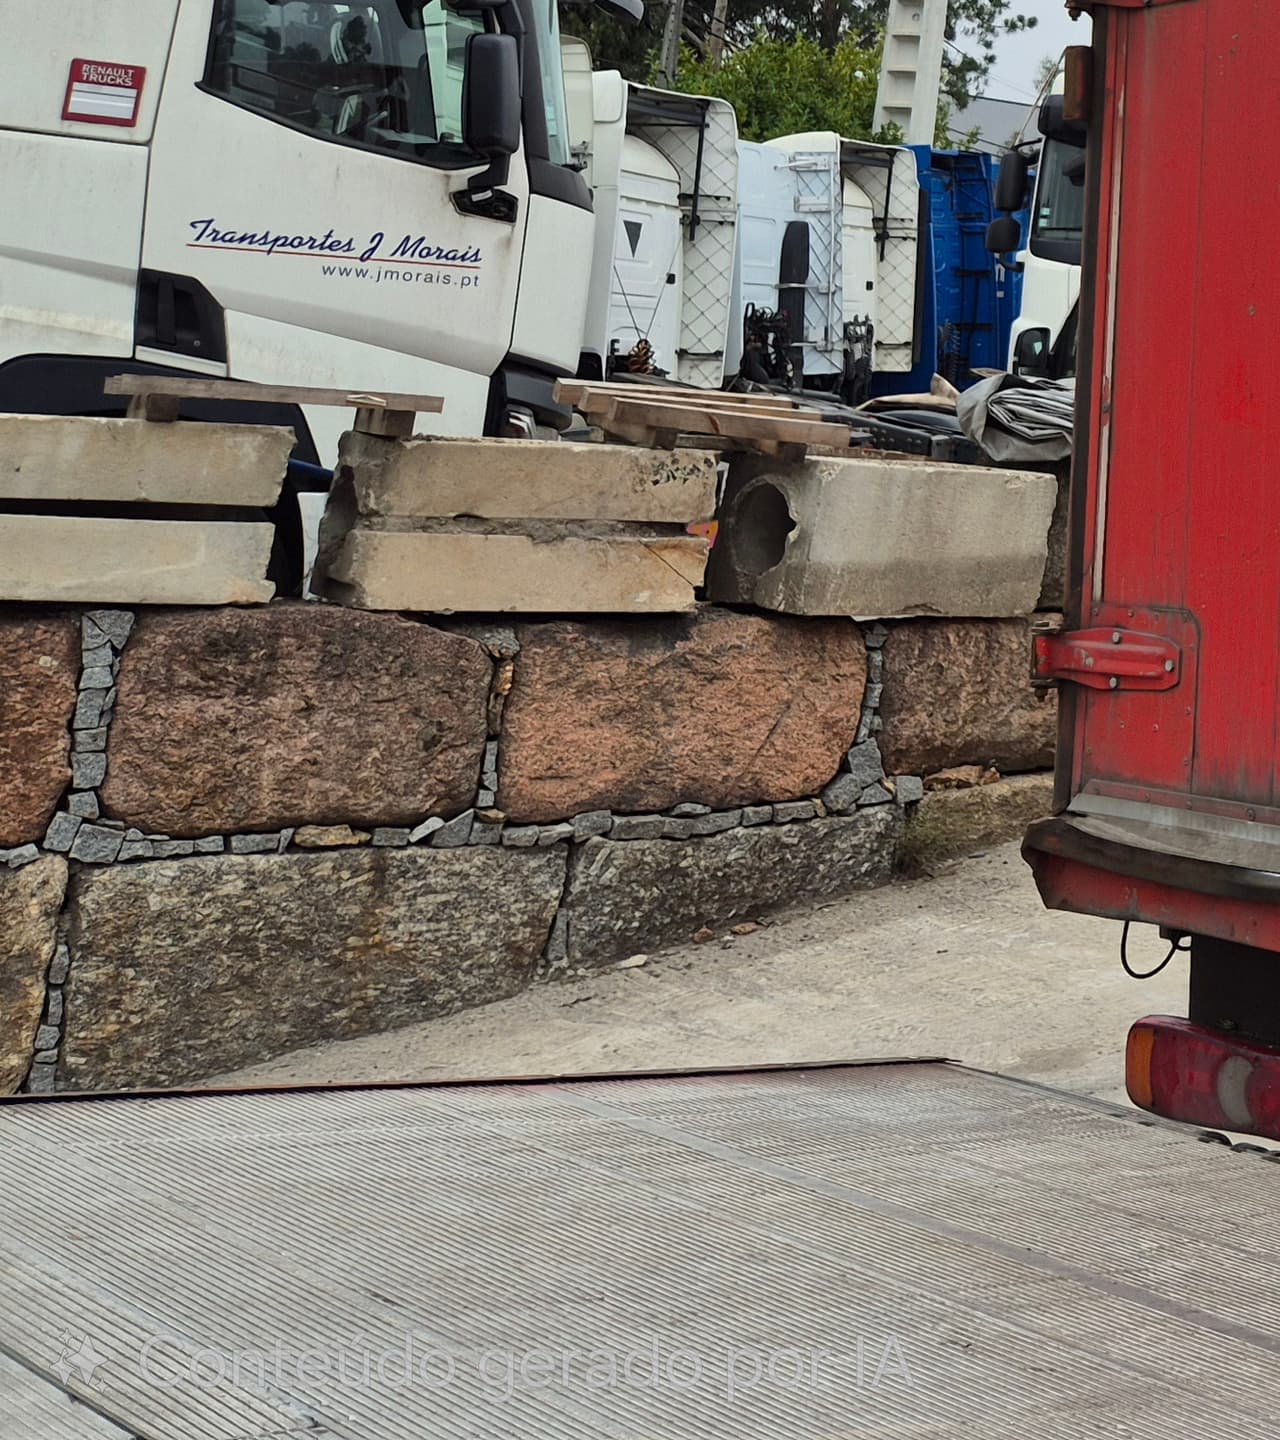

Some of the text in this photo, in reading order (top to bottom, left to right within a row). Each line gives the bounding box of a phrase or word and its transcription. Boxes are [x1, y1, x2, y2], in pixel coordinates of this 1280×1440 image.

[82, 63, 134, 77] RENAULT
[82, 72, 132, 86] TRUCKS
[189, 218, 482, 264] Transportes J Morais
[321, 264, 480, 290] www.jmorais.pt
